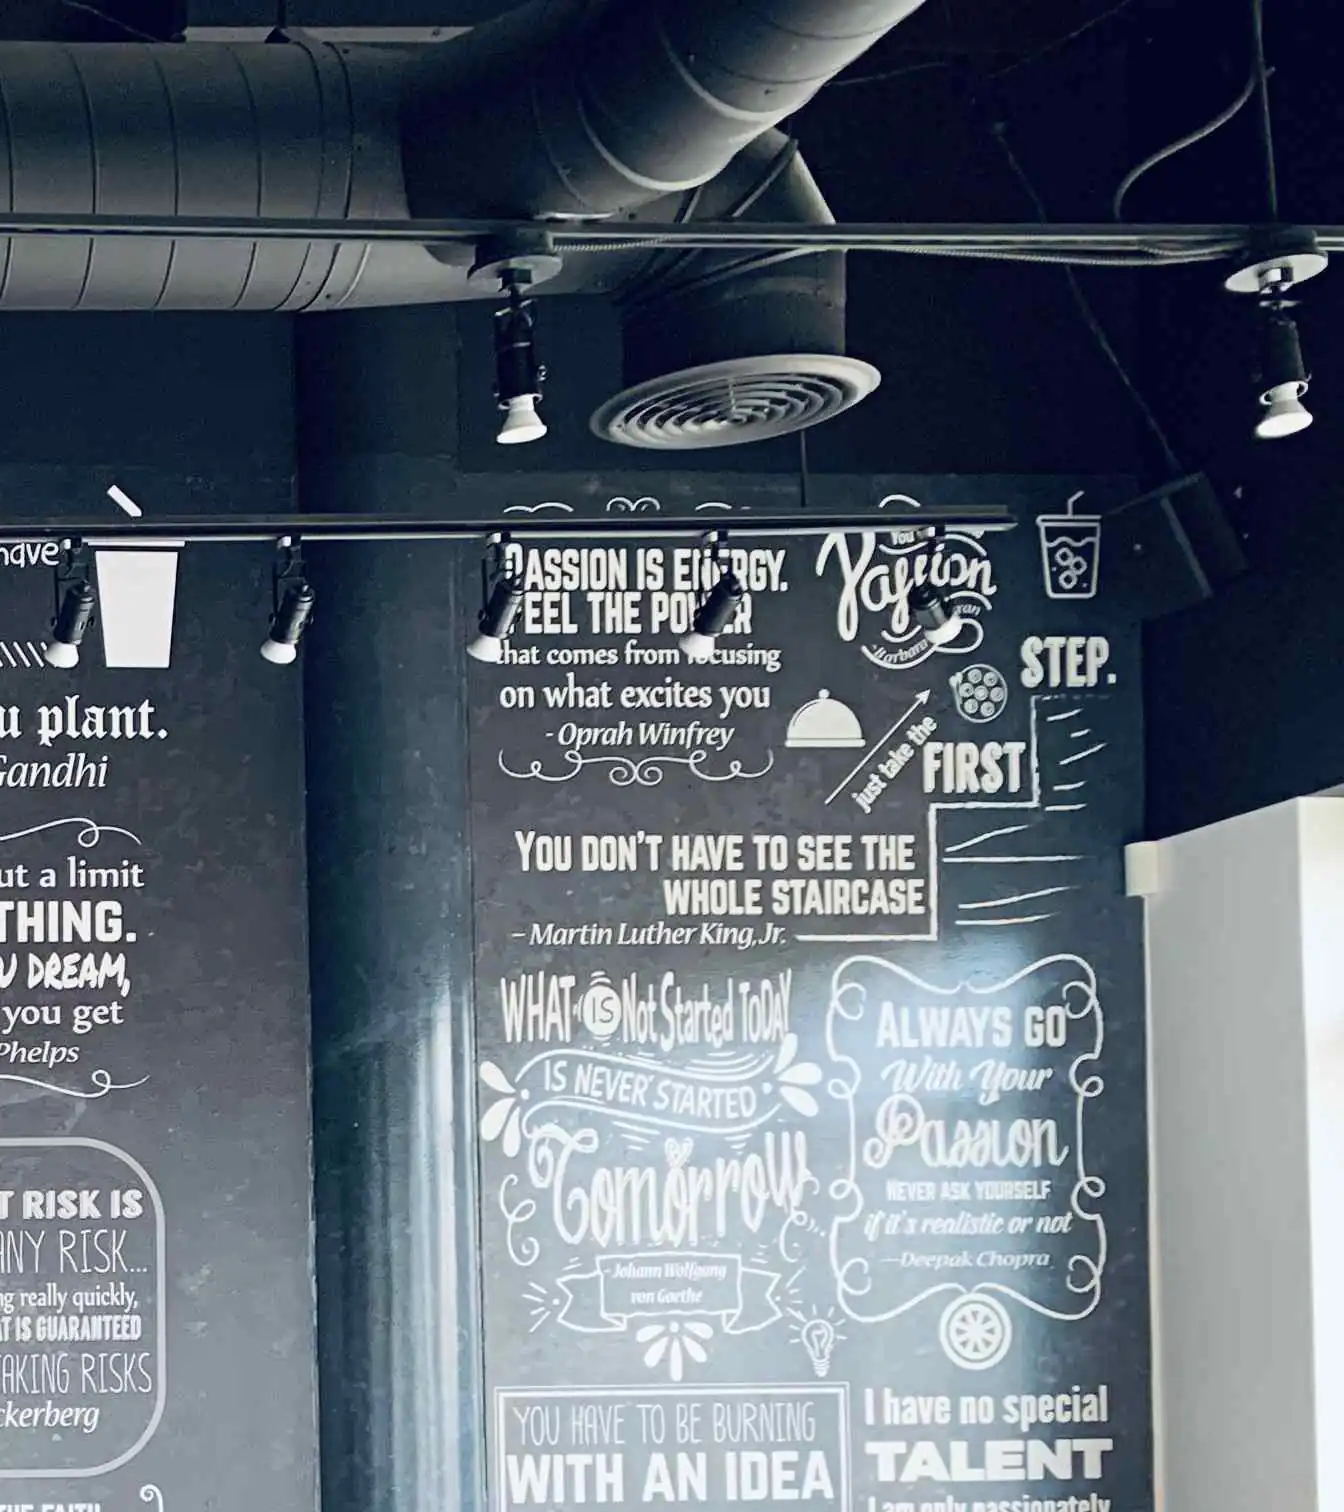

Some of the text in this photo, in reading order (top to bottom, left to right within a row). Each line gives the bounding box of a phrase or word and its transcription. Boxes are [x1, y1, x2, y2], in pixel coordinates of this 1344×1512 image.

[1020, 635, 1117, 689] STEP.
[499, 671, 770, 719] on what excites you
[37, 694, 168, 747] plant.
[851, 716, 937, 814] just take the
[922, 741, 1026, 794] FIRST
[39, 868, 56, 888] a
[67, 855, 145, 888] limit
[581, 830, 663, 872] DON'T
[671, 834, 744, 871] HAVE
[752, 834, 788, 871] TO
[797, 834, 853, 871] SEE
[860, 834, 916, 871] THE
[662, 878, 926, 916] WHOLE STAIRCASE
[22, 1189, 102, 1220] RISK
[110, 1189, 143, 1219] IS
[886, 1180, 1050, 1201] NEVER ASK YOURSELF
[19, 1282, 68, 1314] really
[72, 1281, 139, 1314] quickly,
[506, 1450, 834, 1504] WITH AN IDEA
[865, 1438, 1113, 1482] TALENT
